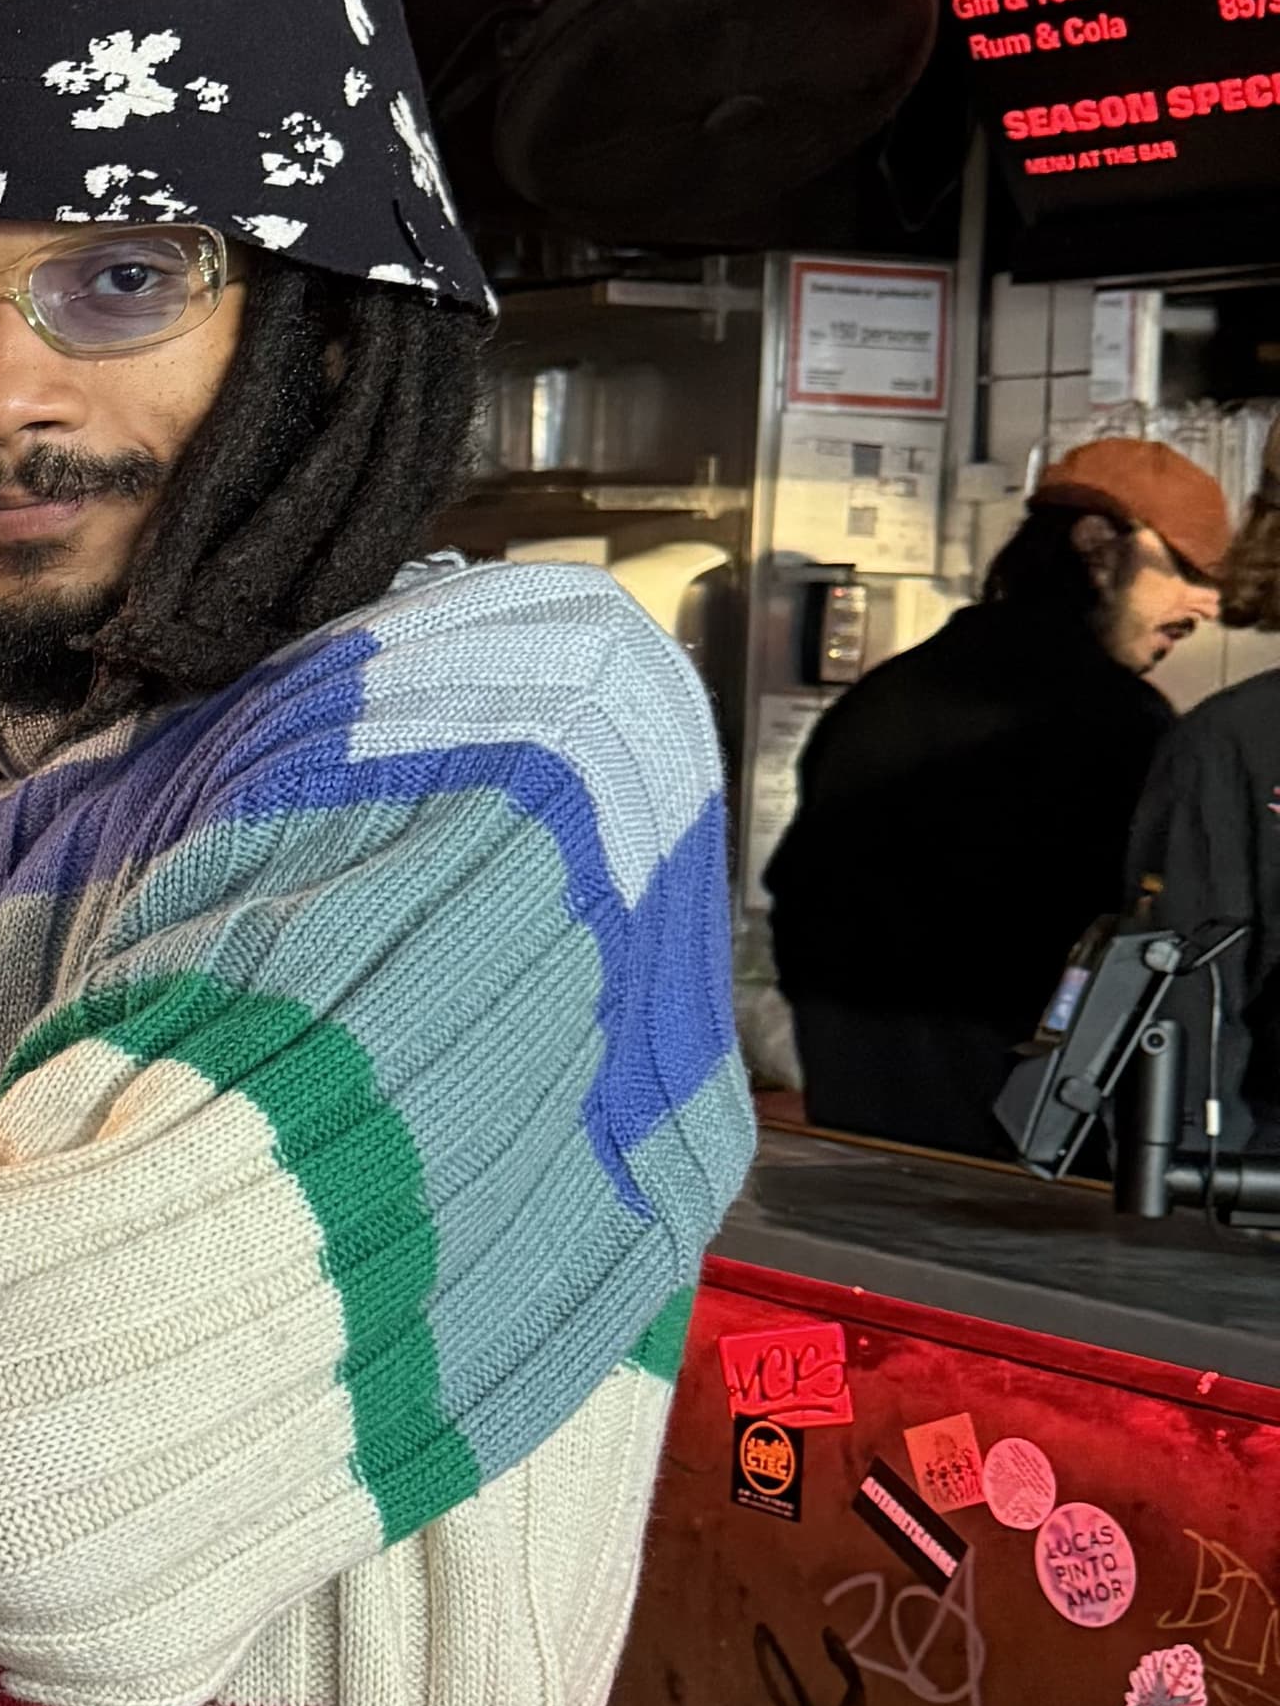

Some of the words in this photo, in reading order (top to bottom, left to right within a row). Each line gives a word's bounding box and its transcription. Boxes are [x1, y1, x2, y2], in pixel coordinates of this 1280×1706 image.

[969, 32, 1031, 60] Rum
[1035, 22, 1061, 51] &
[1063, 13, 1128, 46] Cola
[1002, 90, 1159, 140] SEASON
[1024, 154, 1076, 175] MENU
[1079, 150, 1101, 169] AT
[1102, 144, 1138, 166] THE
[1138, 140, 1178, 162] BAR
[1047, 1525, 1115, 1560] LUCAS
[1055, 1553, 1117, 1584] PINTO
[1065, 1579, 1125, 1609] AMOR
